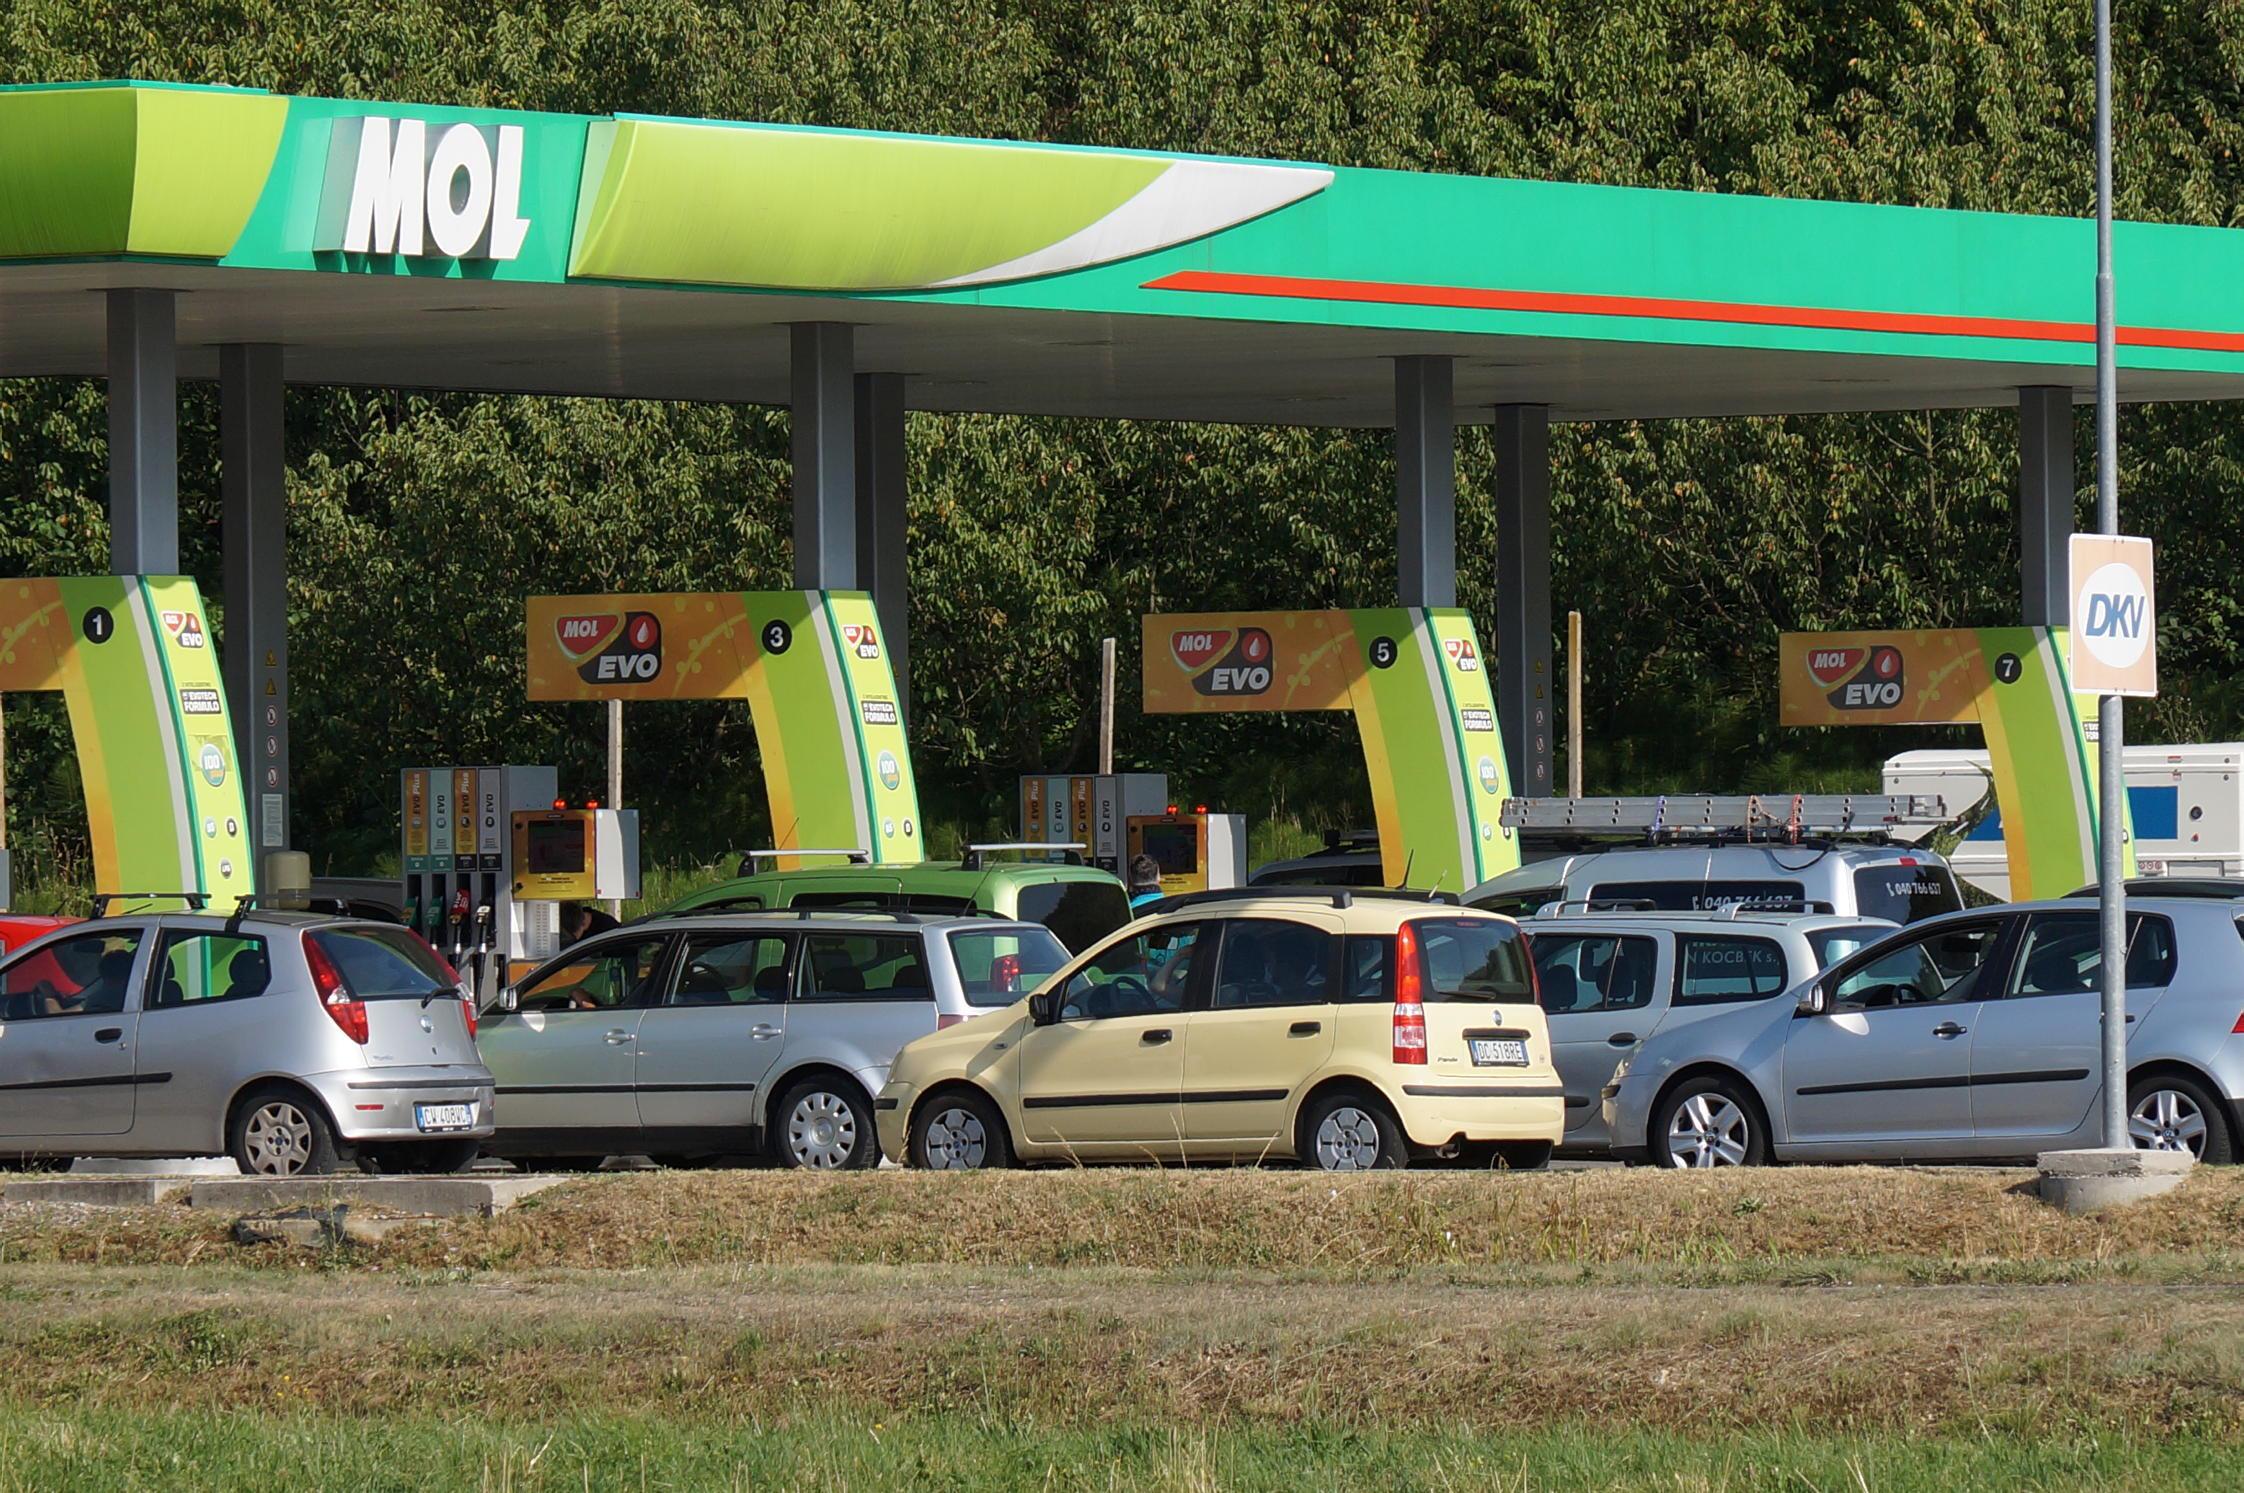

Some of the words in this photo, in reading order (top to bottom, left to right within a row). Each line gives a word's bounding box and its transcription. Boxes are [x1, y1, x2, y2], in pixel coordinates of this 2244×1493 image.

[343, 116, 532, 260] MOL
[91, 614, 103, 636] 1
[2085, 593, 2146, 639] DKV
[563, 620, 600, 638] MOL
[769, 626, 784, 648] 3
[181, 632, 203, 647] EVO
[1178, 634, 1213, 652] MOL
[860, 644, 879, 658] EVO
[1376, 642, 1390, 663] 5
[1813, 652, 1847, 669] MOL
[597, 654, 659, 680] EVO
[1460, 657, 1478, 670] EVO
[2001, 658, 2014, 678] 7
[1210, 667, 1270, 692] EVO
[1845, 682, 1901, 706] EVO
[203, 754, 221, 770] 100
[436, 794, 446, 815] EVO
[485, 793, 494, 813] EVO
[1054, 800, 1063, 820] EVO
[1102, 800, 1111, 819] EVO
[1895, 882, 1911, 895] 040
[1911, 882, 1928, 895] 766
[1928, 882, 1941, 895] 637
[1704, 895, 1731, 909] 040
[1735, 895, 1760, 909] 766
[1764, 895, 1793, 909] 637
[1702, 950, 1762, 964] KOCBK
[1477, 1043, 1491, 1060] DC
[1492, 1043, 1523, 1060] 518RE
